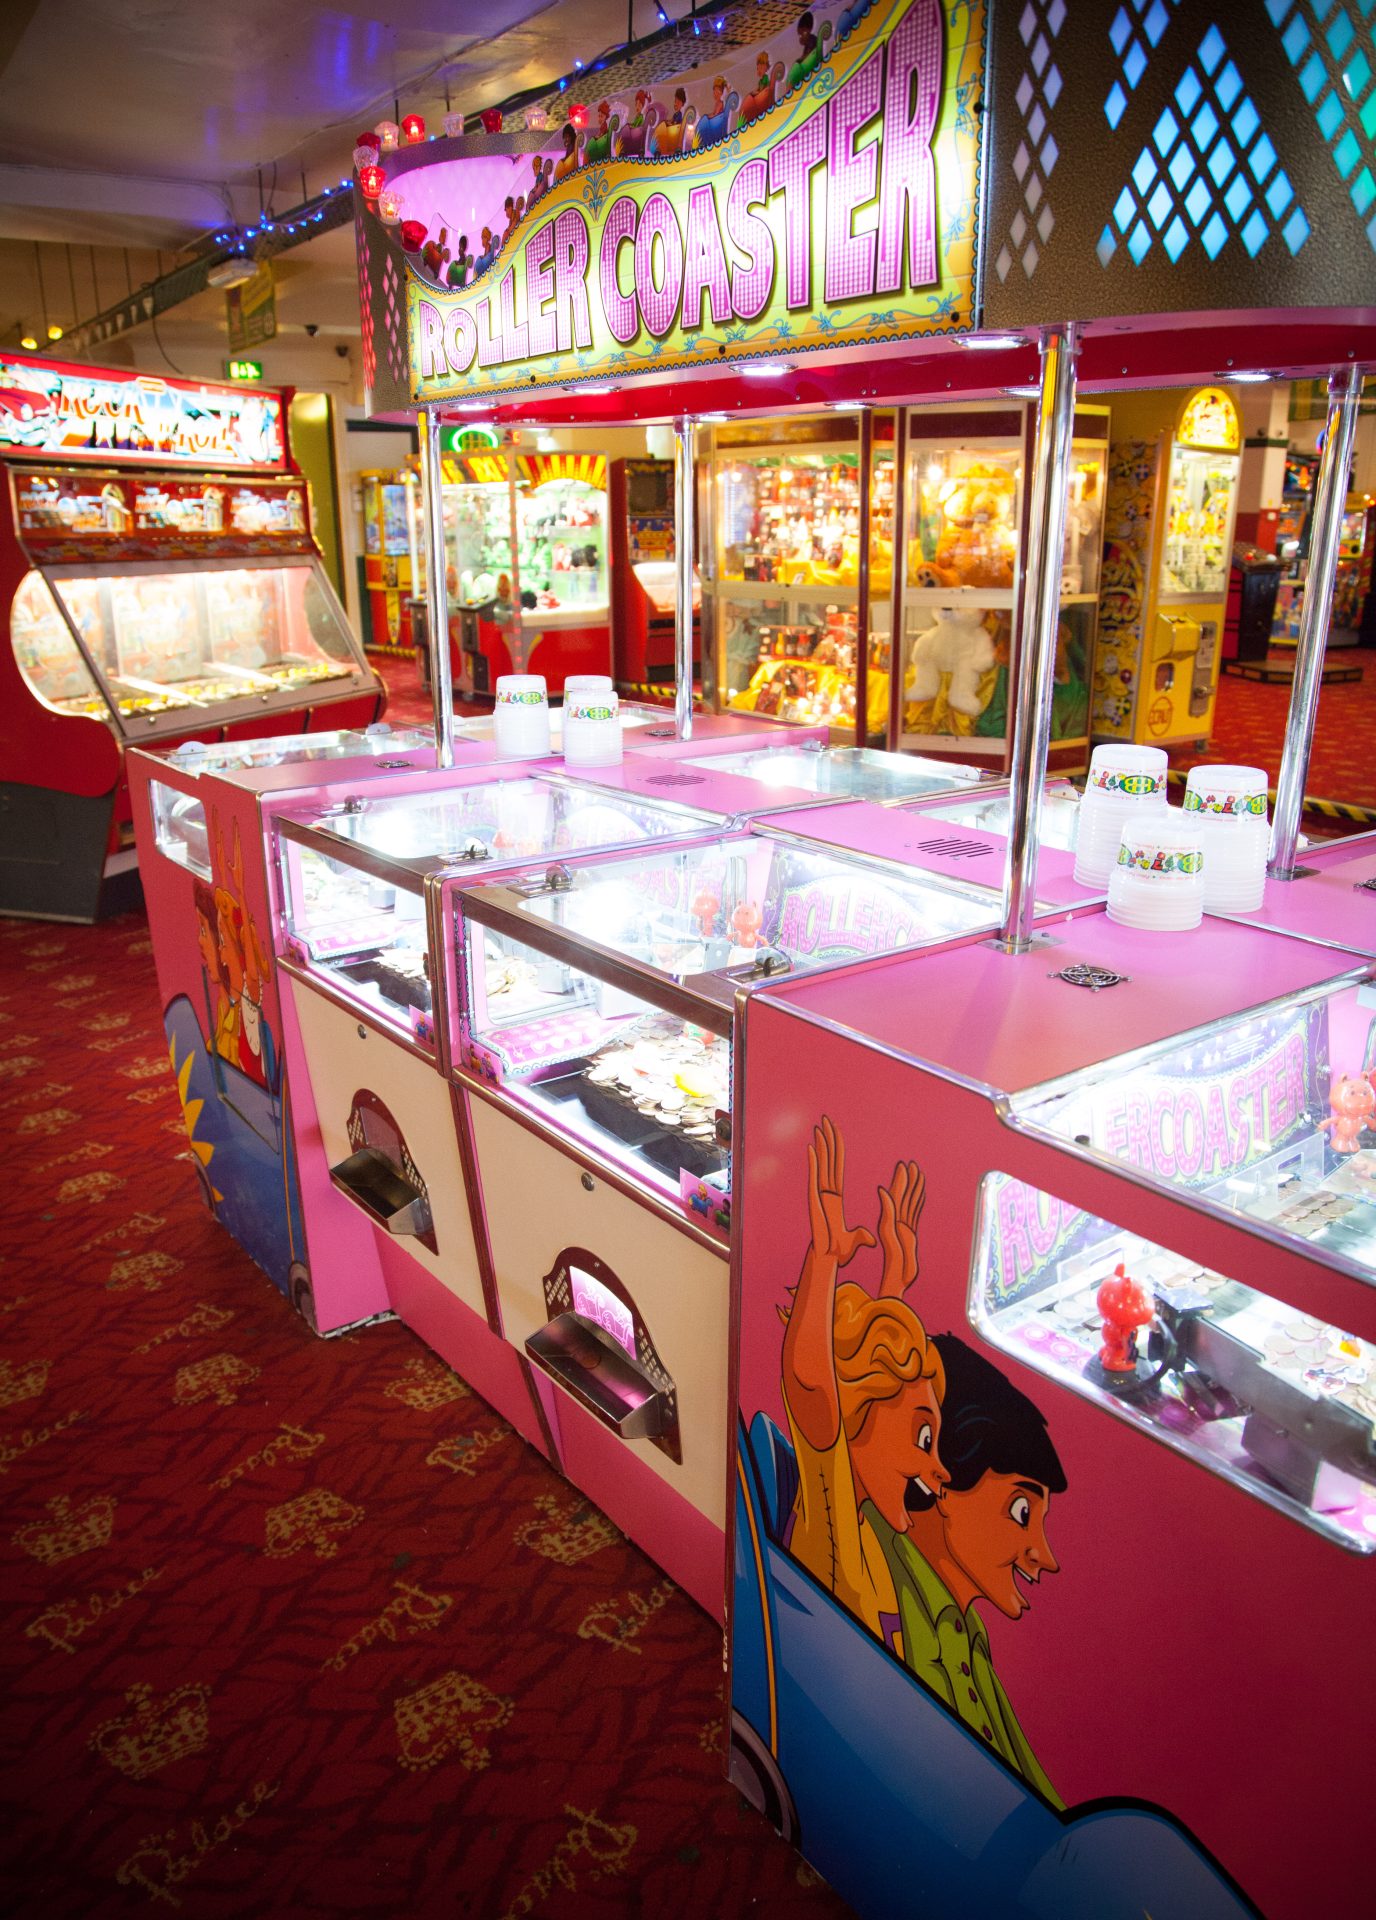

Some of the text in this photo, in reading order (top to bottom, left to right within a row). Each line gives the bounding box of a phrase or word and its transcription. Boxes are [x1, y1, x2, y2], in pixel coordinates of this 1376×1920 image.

[420, 0, 944, 378] ROLLER COASTER
[208, 1422, 327, 1491] Palace
[25, 1564, 167, 1656] Palace
[321, 1581, 455, 1673] Palace
[115, 1779, 282, 1910] Palace
